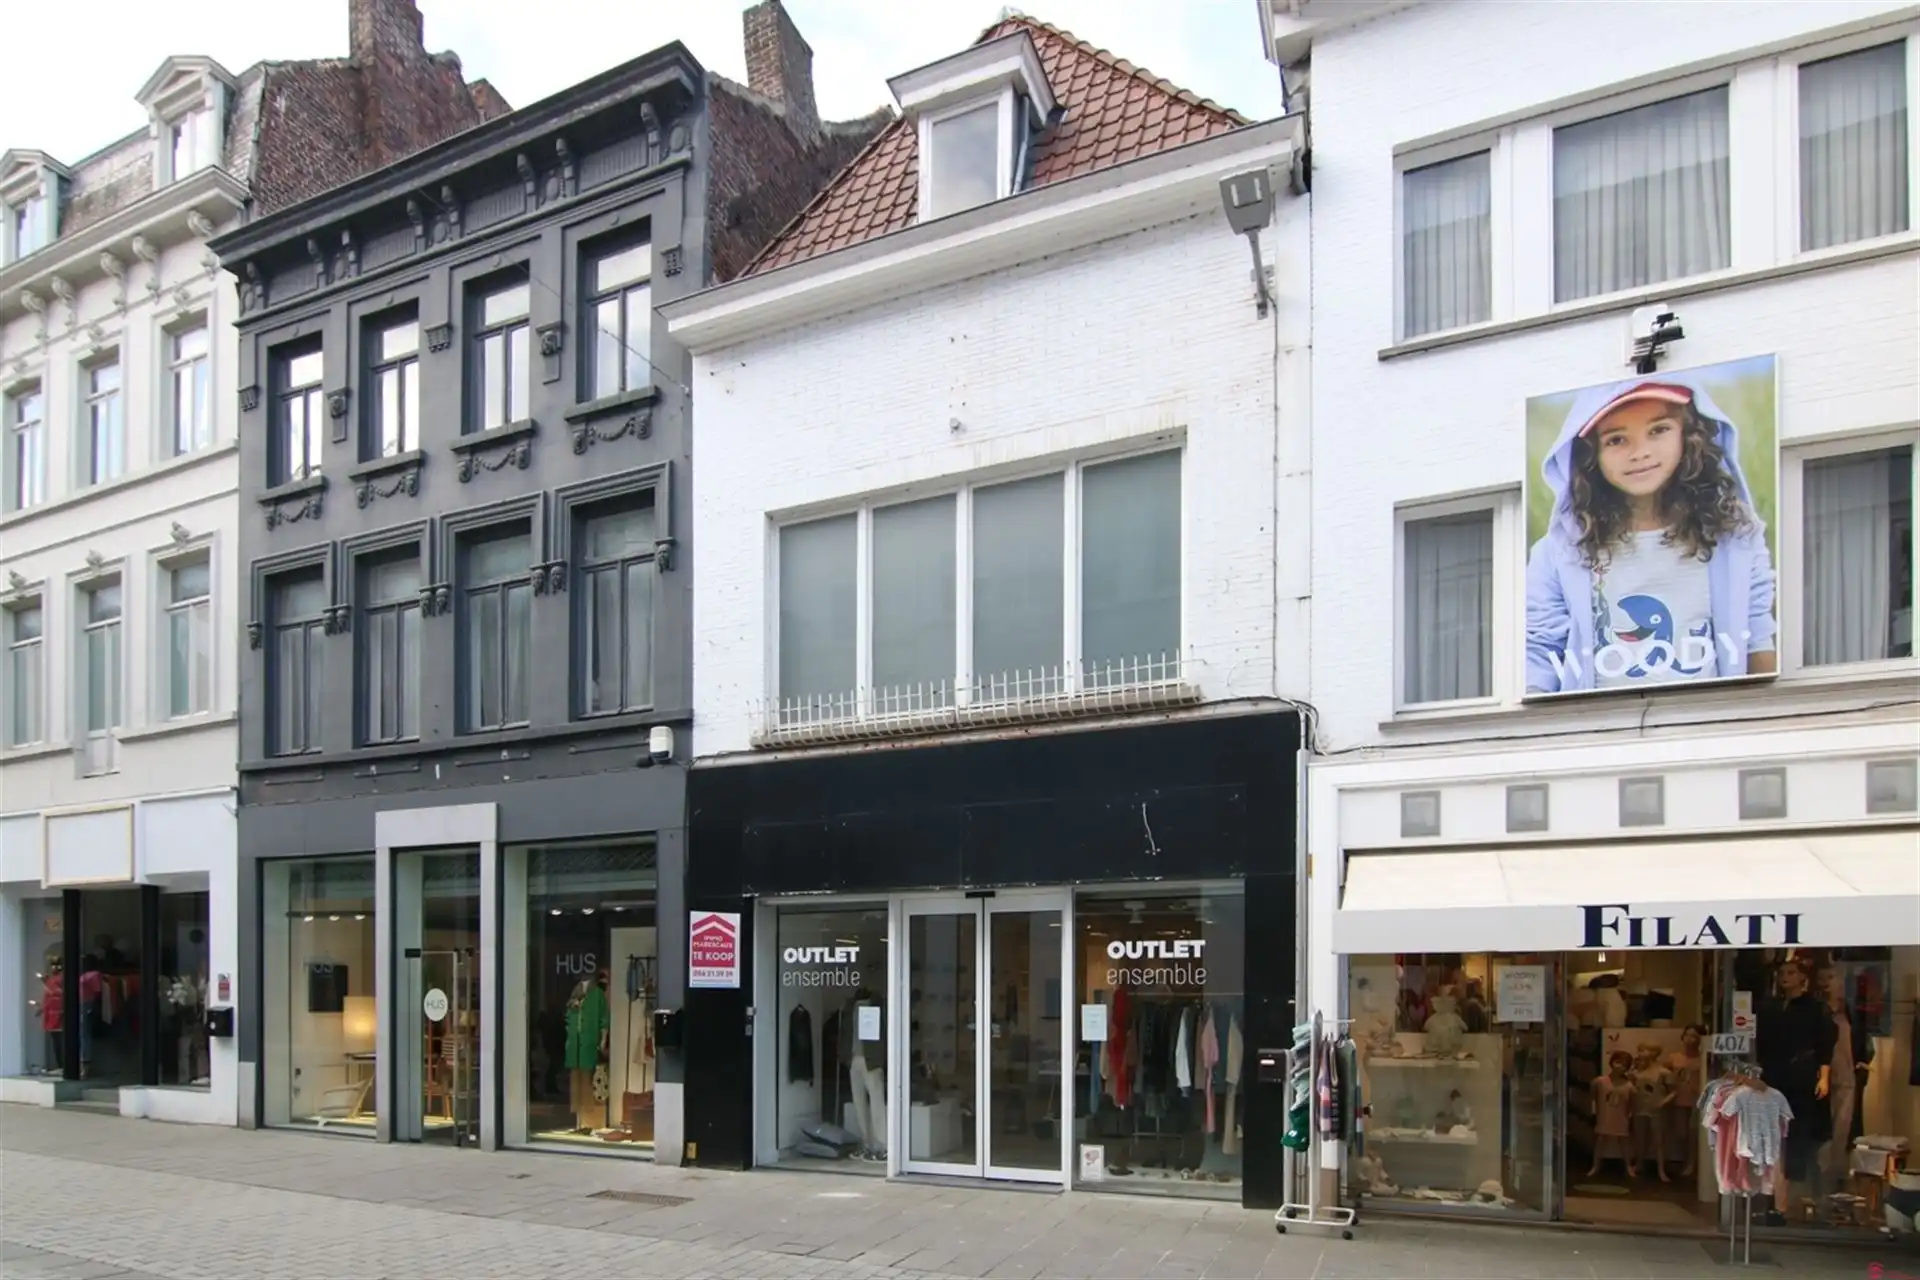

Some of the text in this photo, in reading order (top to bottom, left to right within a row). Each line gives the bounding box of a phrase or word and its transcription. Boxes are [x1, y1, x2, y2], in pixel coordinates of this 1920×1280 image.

[1547, 631, 1750, 685] WOODY
[1577, 904, 1804, 948] FILATI
[693, 951, 733, 961] TE KOOP
[783, 946, 860, 964] OUTLET
[1106, 939, 1206, 960] OUTLET
[556, 952, 597, 976] HUS
[1106, 962, 1207, 985] ensemble
[782, 966, 860, 987] ensemble
[426, 999, 445, 1010] HUS
